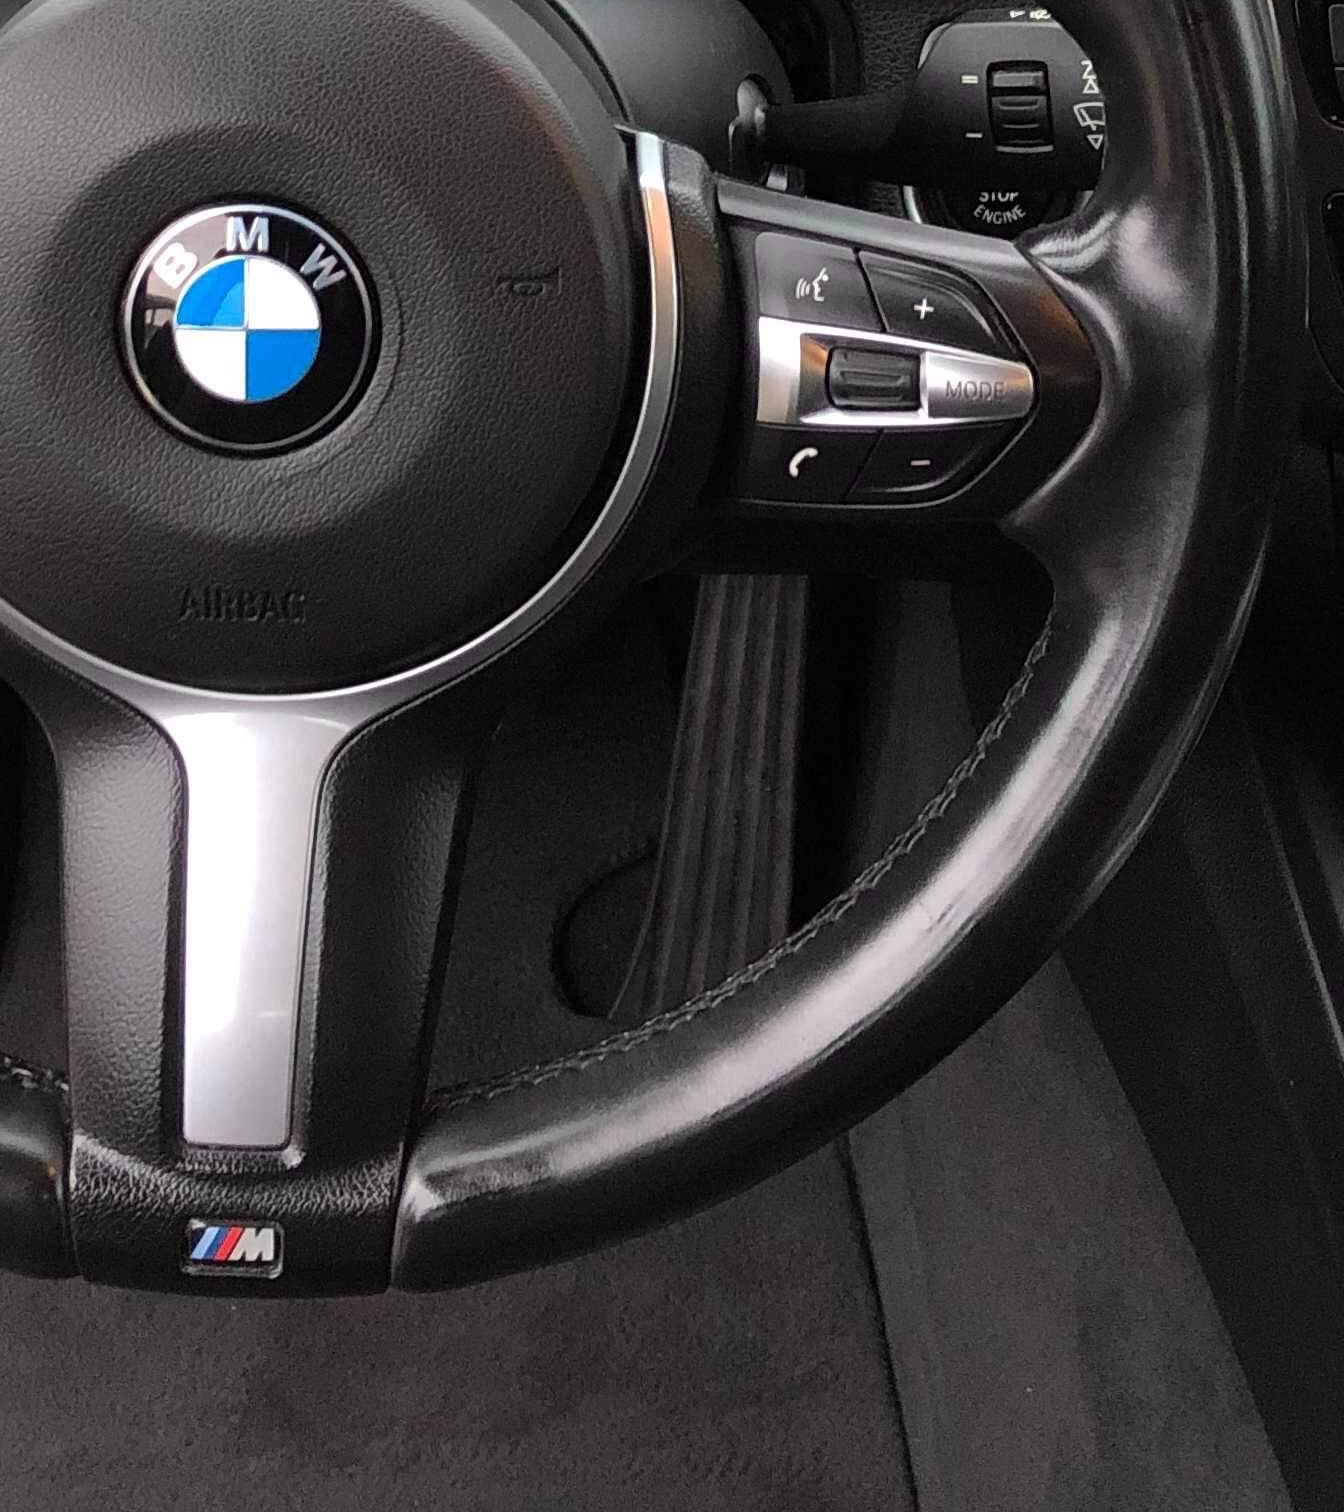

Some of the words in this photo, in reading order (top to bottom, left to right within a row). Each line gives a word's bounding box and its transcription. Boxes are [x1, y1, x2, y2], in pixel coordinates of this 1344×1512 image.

[974, 204, 1027, 225] ENGINE
[155, 215, 348, 291] BMW
[944, 380, 1006, 401] MODE
[177, 590, 307, 624] AIRBAG
